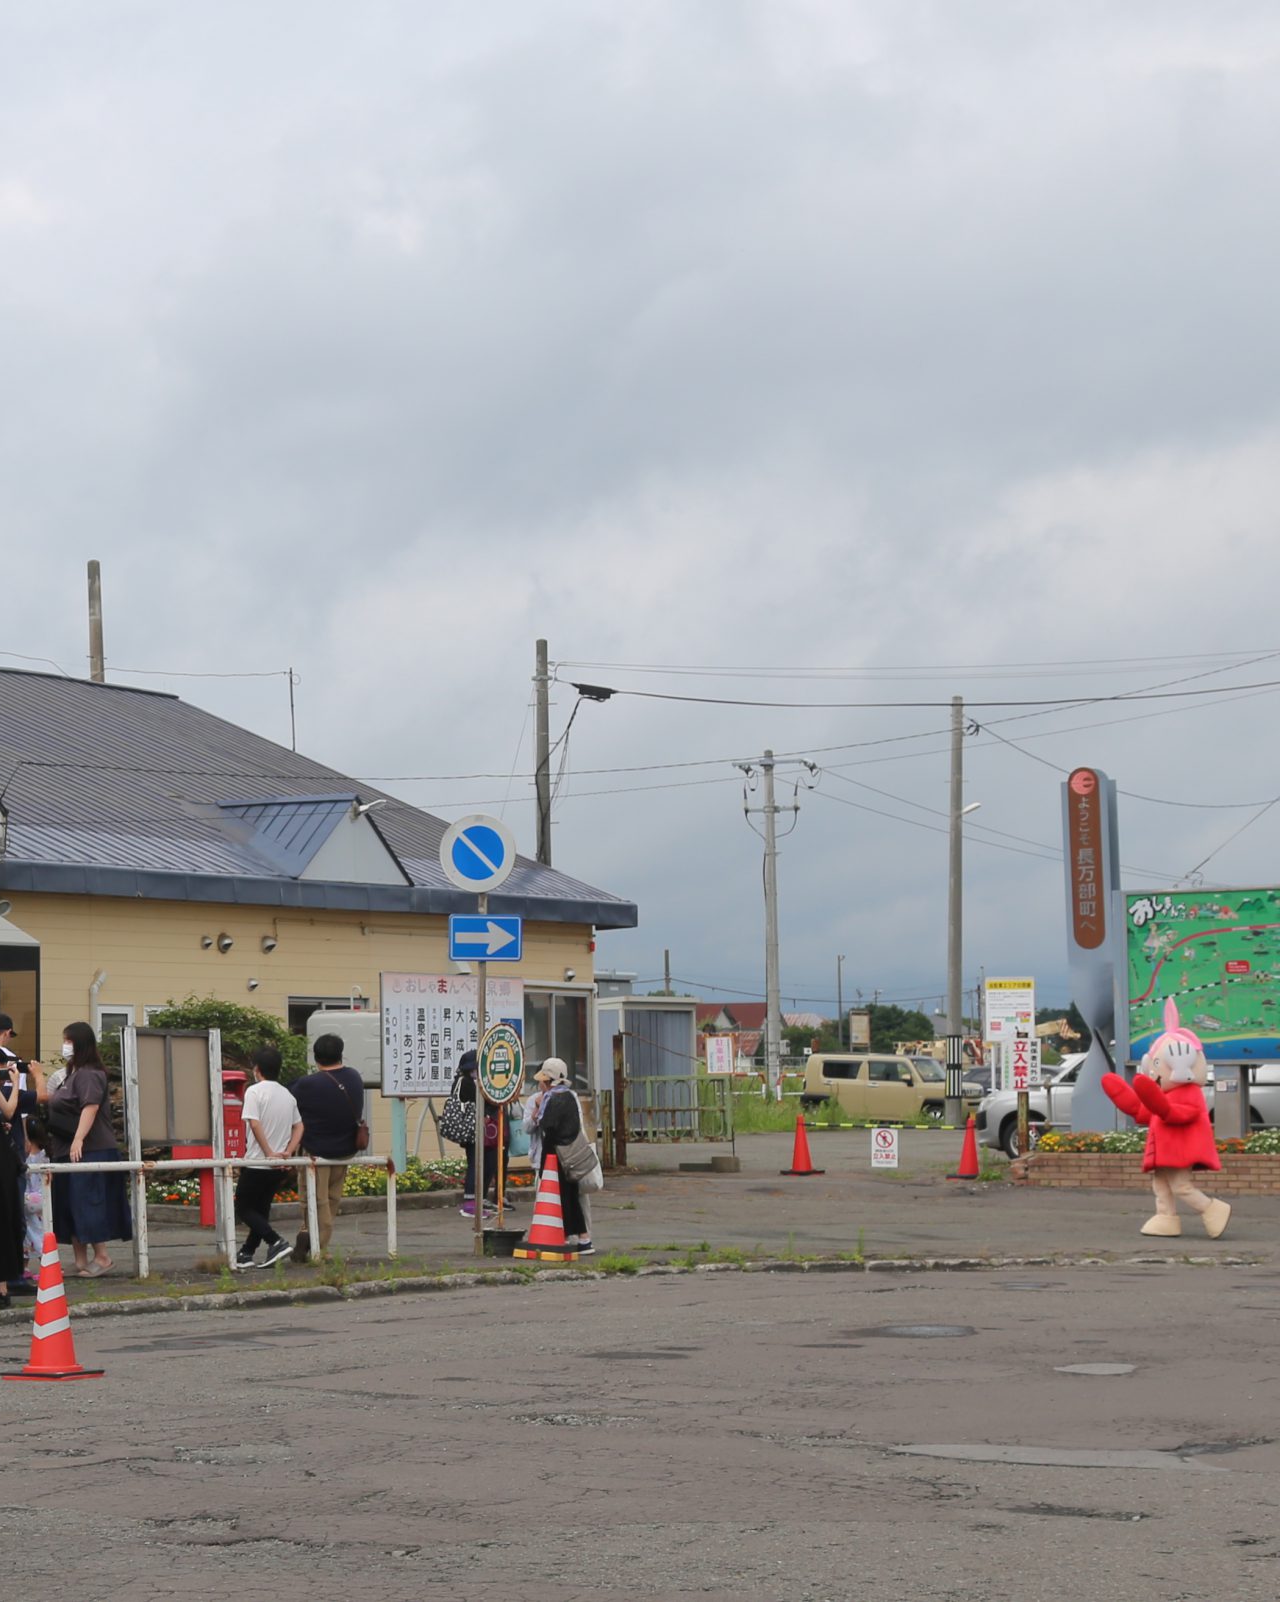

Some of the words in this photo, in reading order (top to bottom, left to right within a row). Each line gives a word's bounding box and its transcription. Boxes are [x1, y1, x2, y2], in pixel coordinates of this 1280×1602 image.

[1077, 796, 1097, 931] ようこそ長万部町へ
[417, 1008, 427, 1080] 温泉ホテル
[1014, 1041, 1028, 1089] 立入禁止
